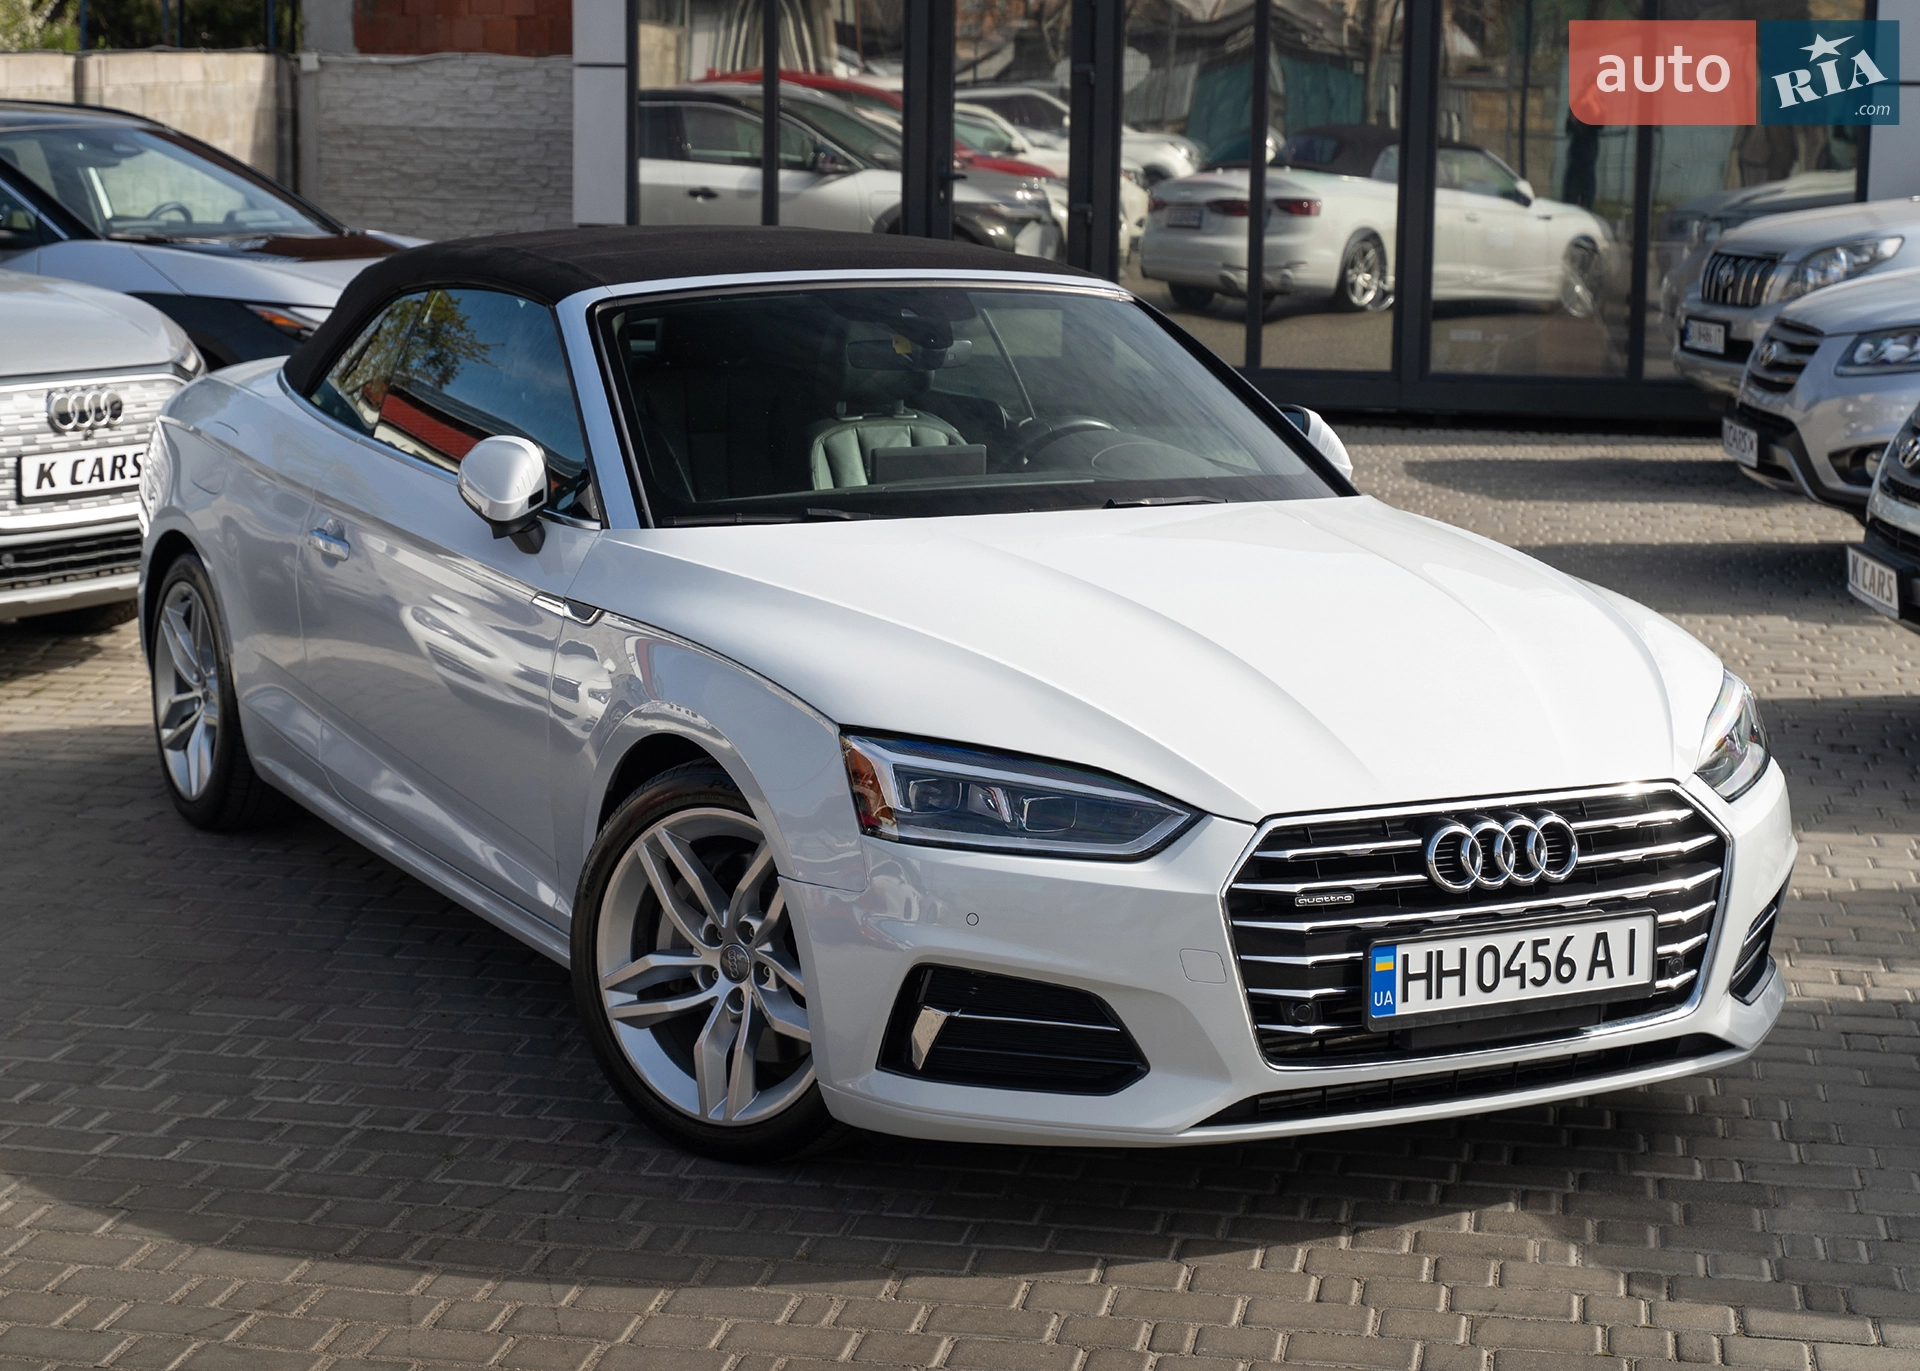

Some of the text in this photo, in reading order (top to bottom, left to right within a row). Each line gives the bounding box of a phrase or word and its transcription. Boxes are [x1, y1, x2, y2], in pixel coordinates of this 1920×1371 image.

[35, 452, 144, 490] K CARS
[1851, 553, 1893, 604] K CARS
[1297, 895, 1352, 906] quattro
[1374, 990, 1394, 1007] UA
